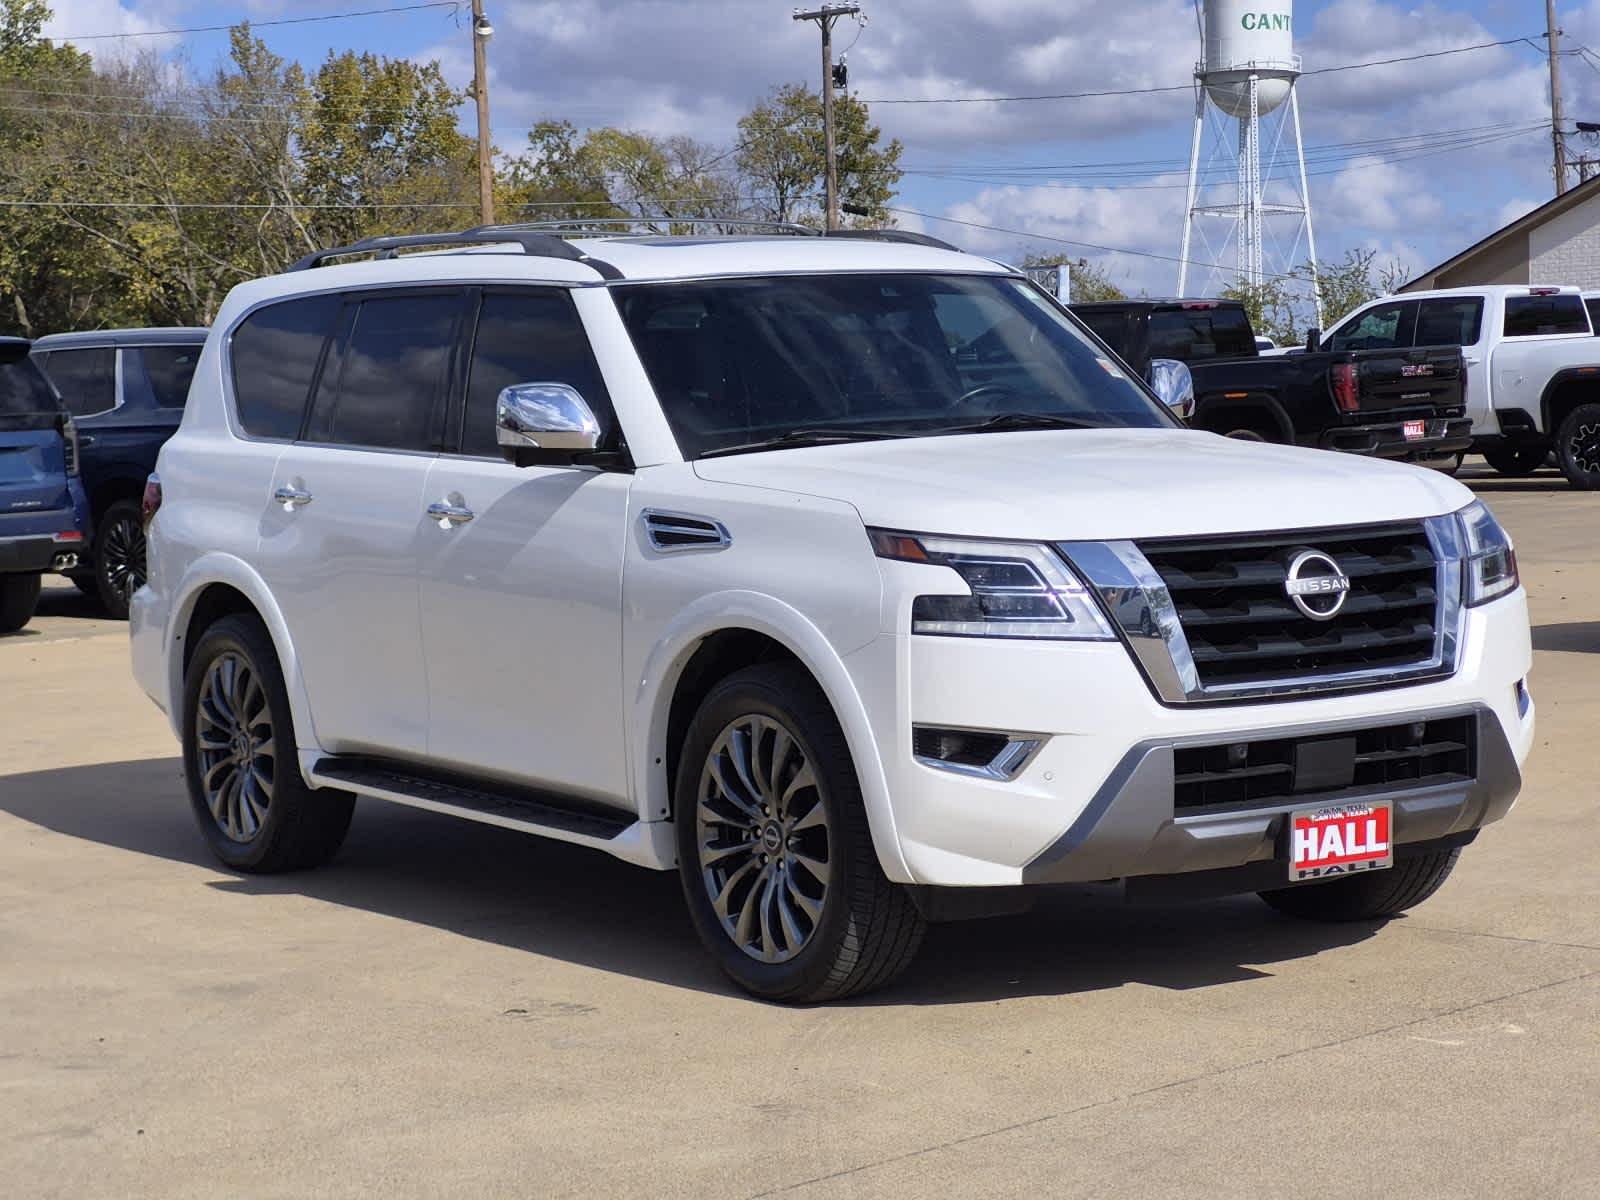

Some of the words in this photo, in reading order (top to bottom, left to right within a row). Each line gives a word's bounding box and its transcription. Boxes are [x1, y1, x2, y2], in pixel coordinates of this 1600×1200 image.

[1404, 424, 1424, 436] HALL
[1287, 577, 1350, 594] NISSAN
[1294, 819, 1387, 863] HALL
[1298, 861, 1388, 879] HALL
